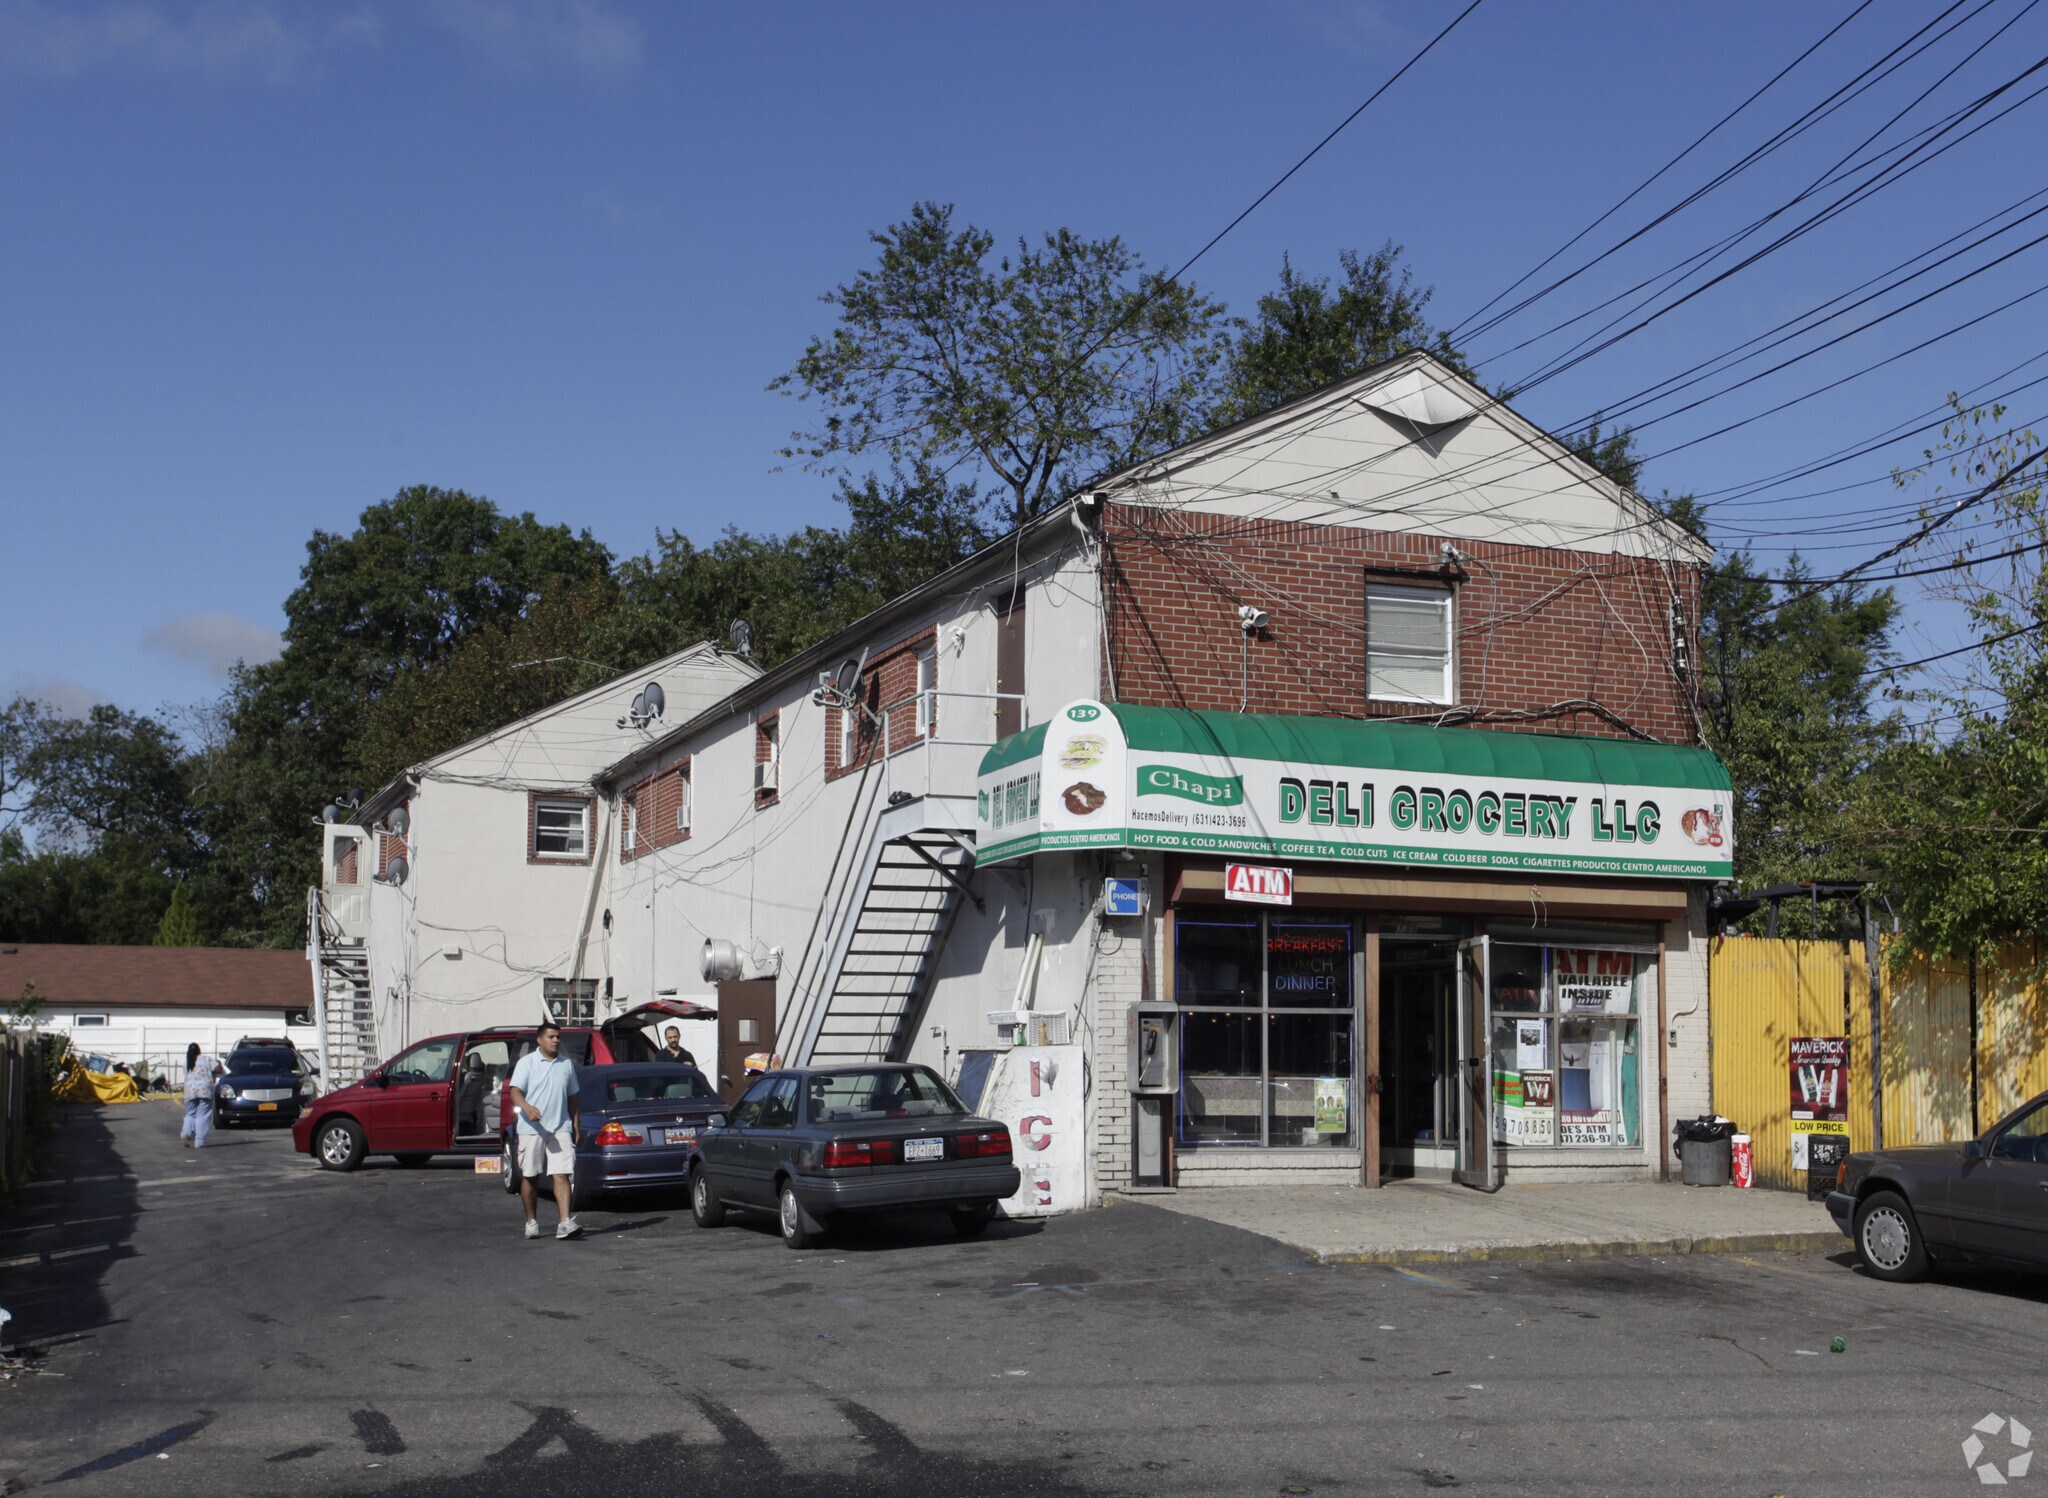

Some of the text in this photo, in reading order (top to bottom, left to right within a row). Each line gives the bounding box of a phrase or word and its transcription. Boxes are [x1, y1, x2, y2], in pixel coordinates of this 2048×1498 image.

[1070, 709, 1097, 718] 139
[1148, 770, 1232, 801] Chapi
[1279, 777, 1661, 844] DELI GROCERY LLC
[1041, 832, 1120, 845] PRODUCTOS CENTRO AMERICANOS
[1134, 833, 1154, 843] HOT
[1156, 835, 1180, 845] FOOD
[1182, 837, 1188, 845] &
[1190, 837, 1216, 848] COLD
[1218, 839, 1277, 851] SANDWICHES
[1281, 843, 1315, 854] COFFEE
[1340, 847, 1365, 857] COLD
[1366, 848, 1388, 858] CUTS
[1393, 850, 1406, 860] ICE
[1408, 851, 1438, 861] CREAM
[1443, 853, 1465, 862] COLD
[1466, 854, 1488, 864] BEER
[1491, 856, 1519, 865] SODAS
[1522, 857, 1571, 868] CIGARETTES
[1572, 860, 1621, 870] PRODUCTOS
[1622, 861, 1654, 872] CENTRO
[1655, 864, 1707, 874] AMERICANOS
[1232, 866, 1285, 895] ATM
[1112, 892, 1138, 900] PHONE
[1266, 938, 1344, 953] BREAKFAST
[1279, 957, 1333, 972] LUNCH
[1557, 948, 1632, 975] ATM
[1275, 975, 1336, 990] DINNER
[1557, 974, 1628, 987] VAILABLE
[1500, 986, 1538, 1000] ATM
[1561, 987, 1613, 1000] INSIDE
[1791, 1041, 1844, 1054] MAVERICK
[1560, 1125, 1607, 1134] OE'S ATM
[1794, 1122, 1844, 1132] LOW PRICE
[1574, 1134, 1625, 1143] 236-976
